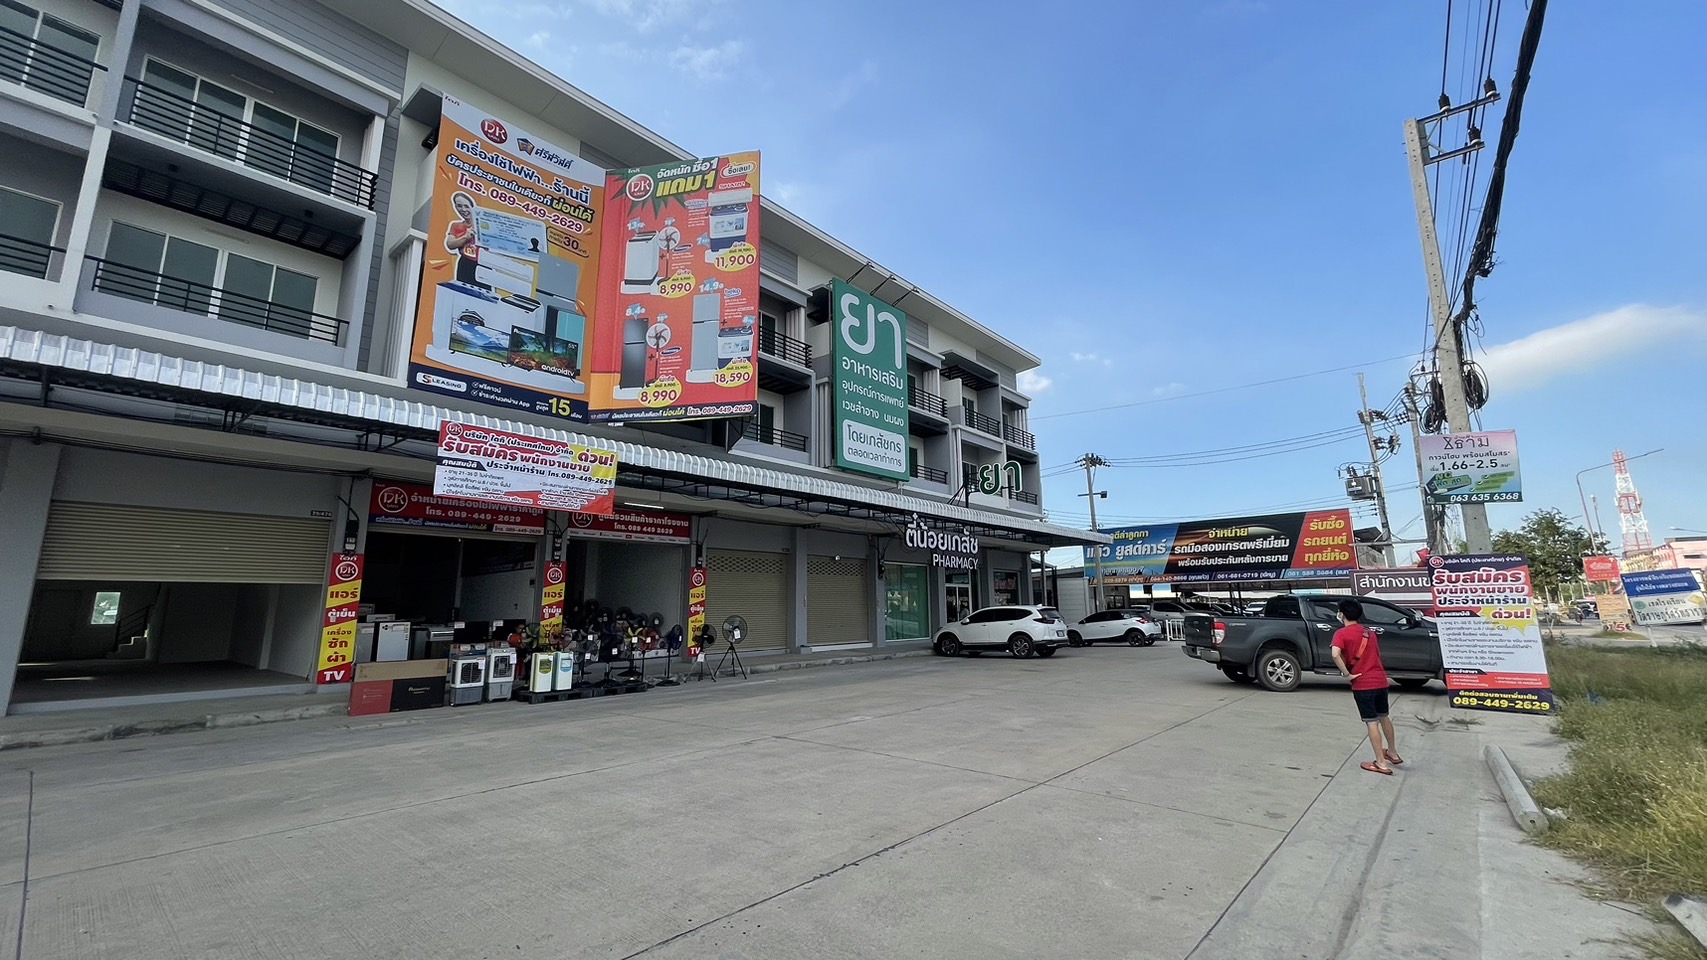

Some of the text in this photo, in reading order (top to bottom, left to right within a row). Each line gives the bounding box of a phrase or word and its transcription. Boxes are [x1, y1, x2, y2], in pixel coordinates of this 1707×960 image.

[484, 122, 506, 140] DK
[631, 180, 650, 192] DK
[458, 173, 486, 195] โทร.
[490, 189, 583, 232] 089-449-2629
[563, 236, 579, 250] 30
[715, 254, 755, 268] 11,900
[660, 282, 692, 295] 8,990
[840, 293, 902, 370] ยา
[715, 372, 750, 384] 18,590
[842, 356, 904, 391] อาหารเสริม
[432, 378, 462, 389] LEASING
[640, 389, 677, 404] 8,990
[842, 380, 904, 409] อุปกรณ์การแพทย์
[549, 398, 571, 416] 15
[702, 405, 752, 415] 089-449-2629
[842, 400, 904, 427] เวชสำอาง นมผง
[465, 431, 488, 441] บริษัท
[507, 437, 555, 452] (ประเทศไทย)
[556, 446, 574, 455] จำกัด
[847, 423, 902, 453] โดยเภสัชกร
[443, 436, 590, 472] รับสมัคร พนักงานขาย
[577, 449, 615, 466] ด่วน!
[848, 446, 902, 467] ตลอดเวลาทำการ
[442, 459, 477, 469] คุณสมบัติ
[487, 460, 545, 476] ประจำหน้าร้าน
[1440, 459, 1498, 471] 1.66-2.5
[979, 461, 1023, 497] ยา
[383, 492, 404, 505] DK
[1450, 492, 1519, 502] 063 635 6368
[425, 506, 445, 516] โทร.
[614, 522, 627, 530] โทร.
[1309, 515, 1344, 531] รับซื้อ
[1208, 526, 1248, 539] จำหน่าย
[1303, 532, 1347, 547] รถยนต์
[932, 554, 979, 570] PHARMACY
[1178, 554, 1289, 567] พร้อมรับประกันหลังการขาย
[1304, 548, 1349, 565] ทุกยี่ห้อ
[1434, 569, 1522, 585] รับสมัคร
[329, 587, 358, 599] แอร์
[544, 588, 563, 598] แอร์
[690, 590, 704, 599] แอร์
[1436, 585, 1525, 595] พนักงานขาย
[1438, 595, 1527, 605] ประจำหน้าร้าน
[1491, 608, 1531, 619] ด่วน!
[327, 627, 352, 636] เครื่อง
[327, 638, 348, 649] ซัก
[327, 650, 346, 663] ผ้า
[690, 647, 701, 655] TV
[324, 670, 345, 681] TV
[1453, 697, 1550, 711] 089-449-2629
